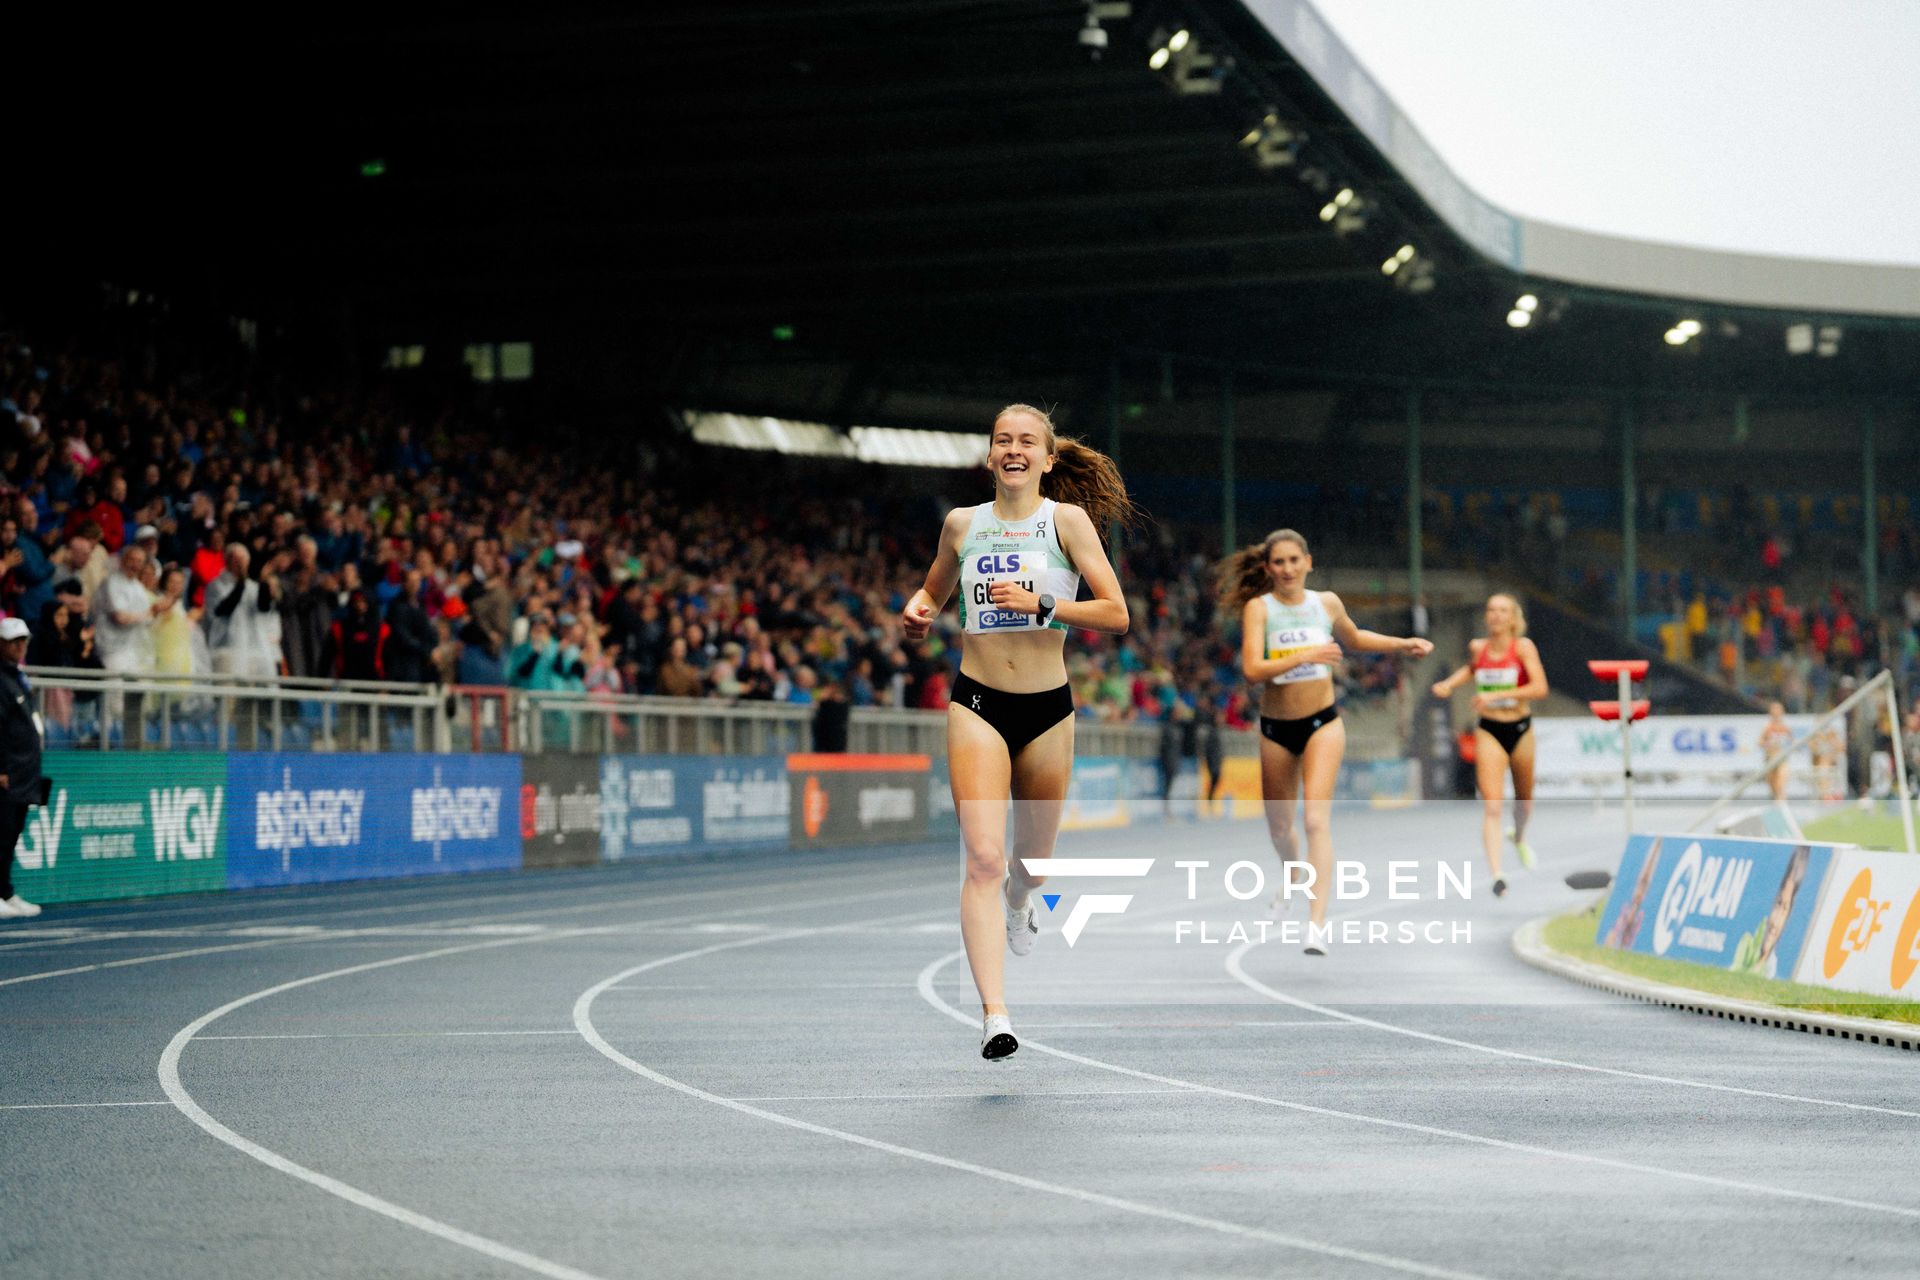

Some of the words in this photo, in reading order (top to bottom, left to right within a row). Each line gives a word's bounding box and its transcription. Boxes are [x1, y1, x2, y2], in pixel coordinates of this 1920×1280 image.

[999, 612, 1027, 621] PLAN
[150, 785, 224, 862] WGV
[1688, 856, 1753, 919] PLAN
